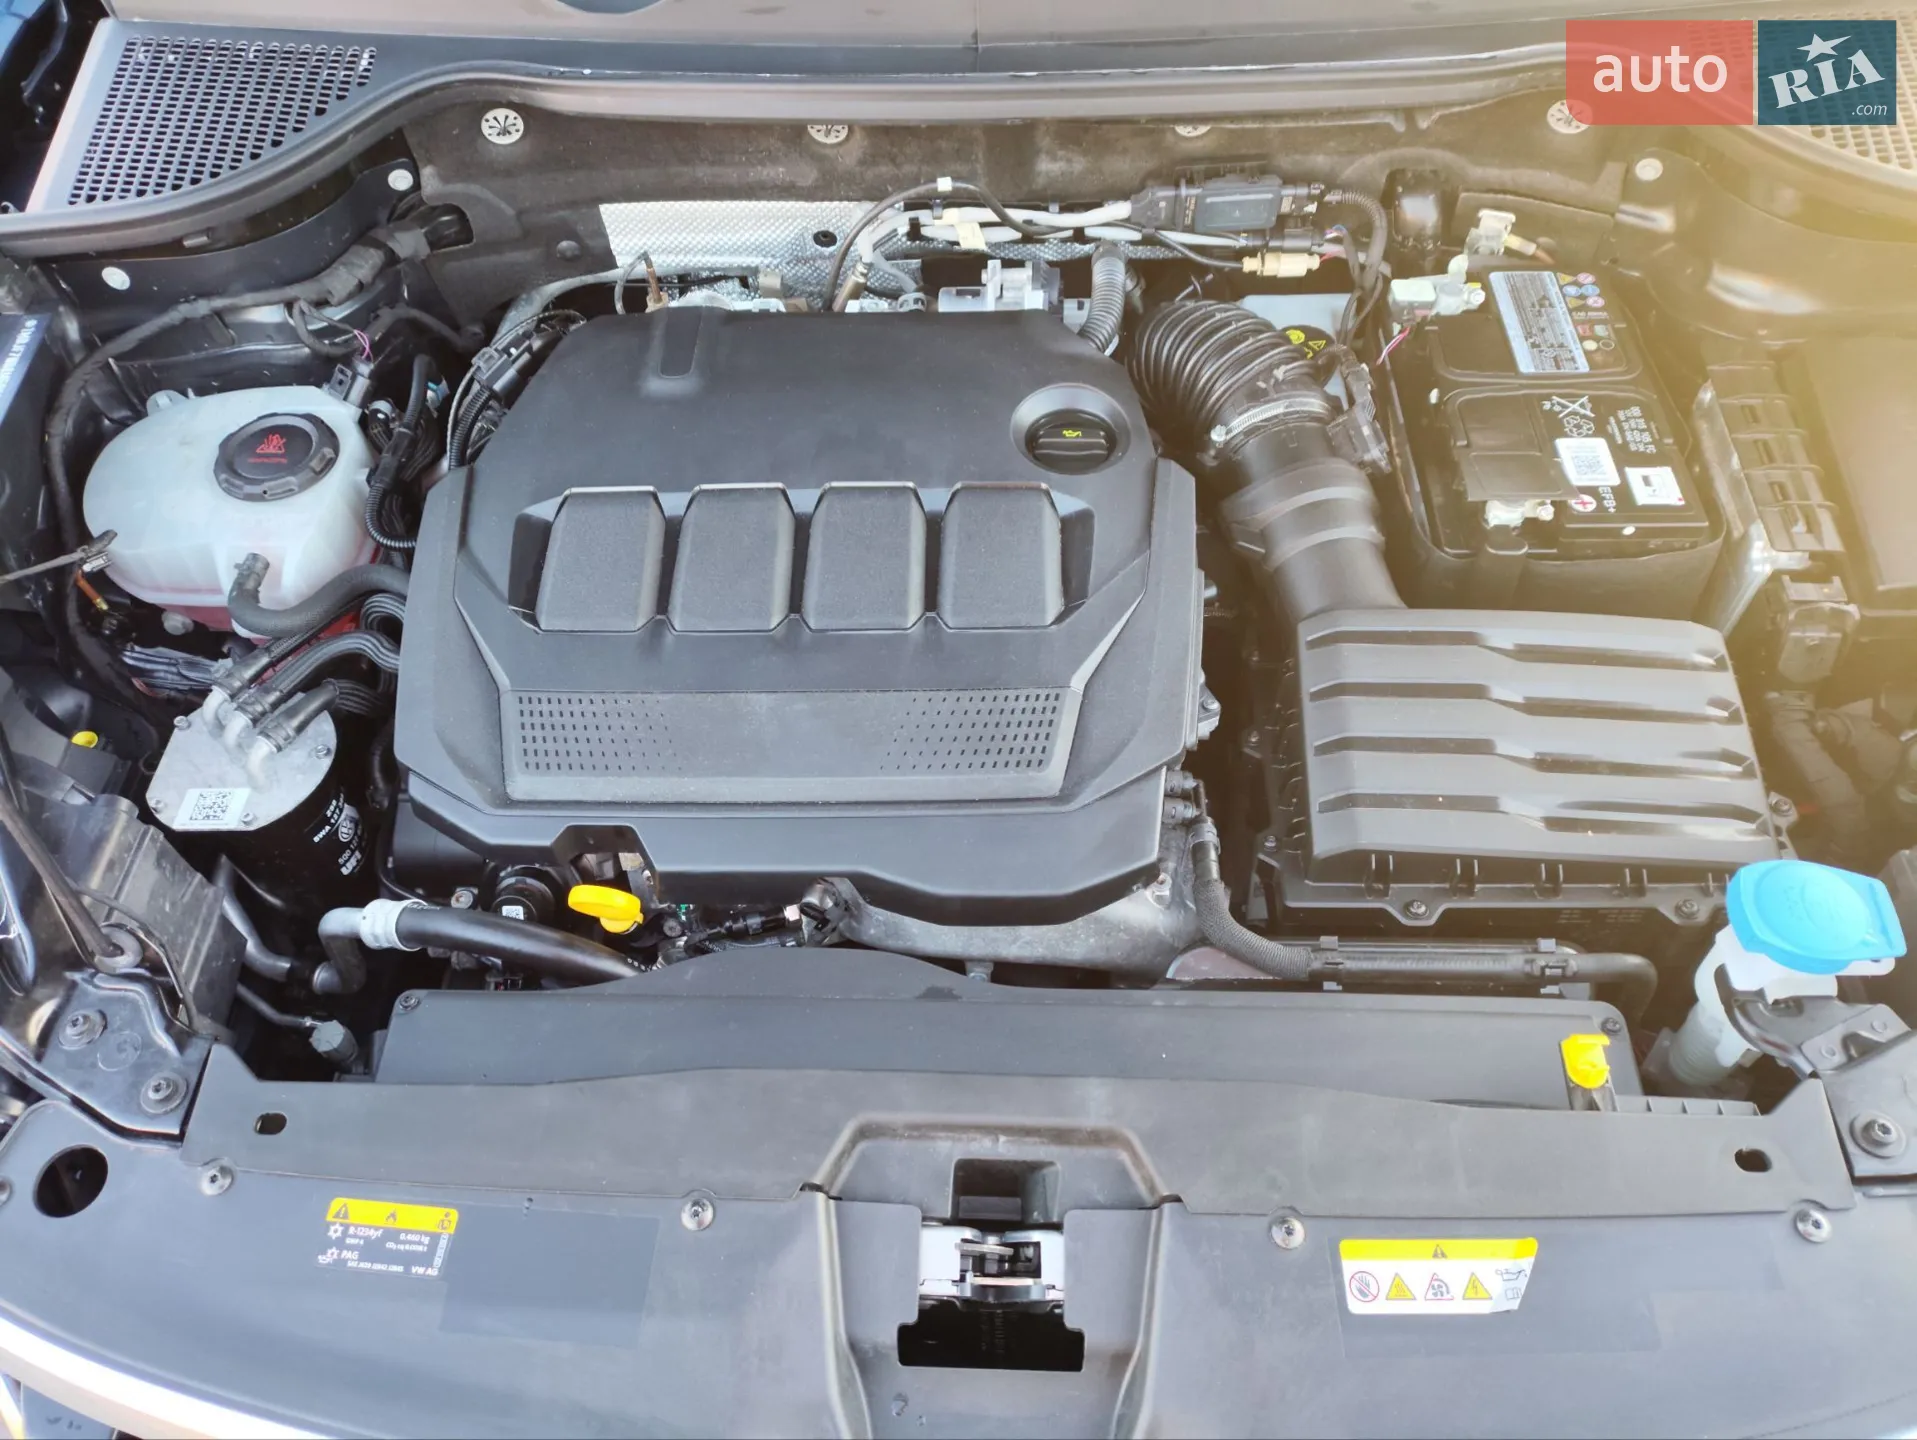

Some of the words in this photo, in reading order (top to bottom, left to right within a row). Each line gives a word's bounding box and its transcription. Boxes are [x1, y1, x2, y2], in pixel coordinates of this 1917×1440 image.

[1598, 486, 1617, 513] EFB+
[348, 1226, 384, 1240] R-1234yf
[421, 1234, 430, 1246] kg
[341, 1249, 359, 1260] PAG
[411, 1265, 426, 1275] VW
[425, 1267, 438, 1276] AG
